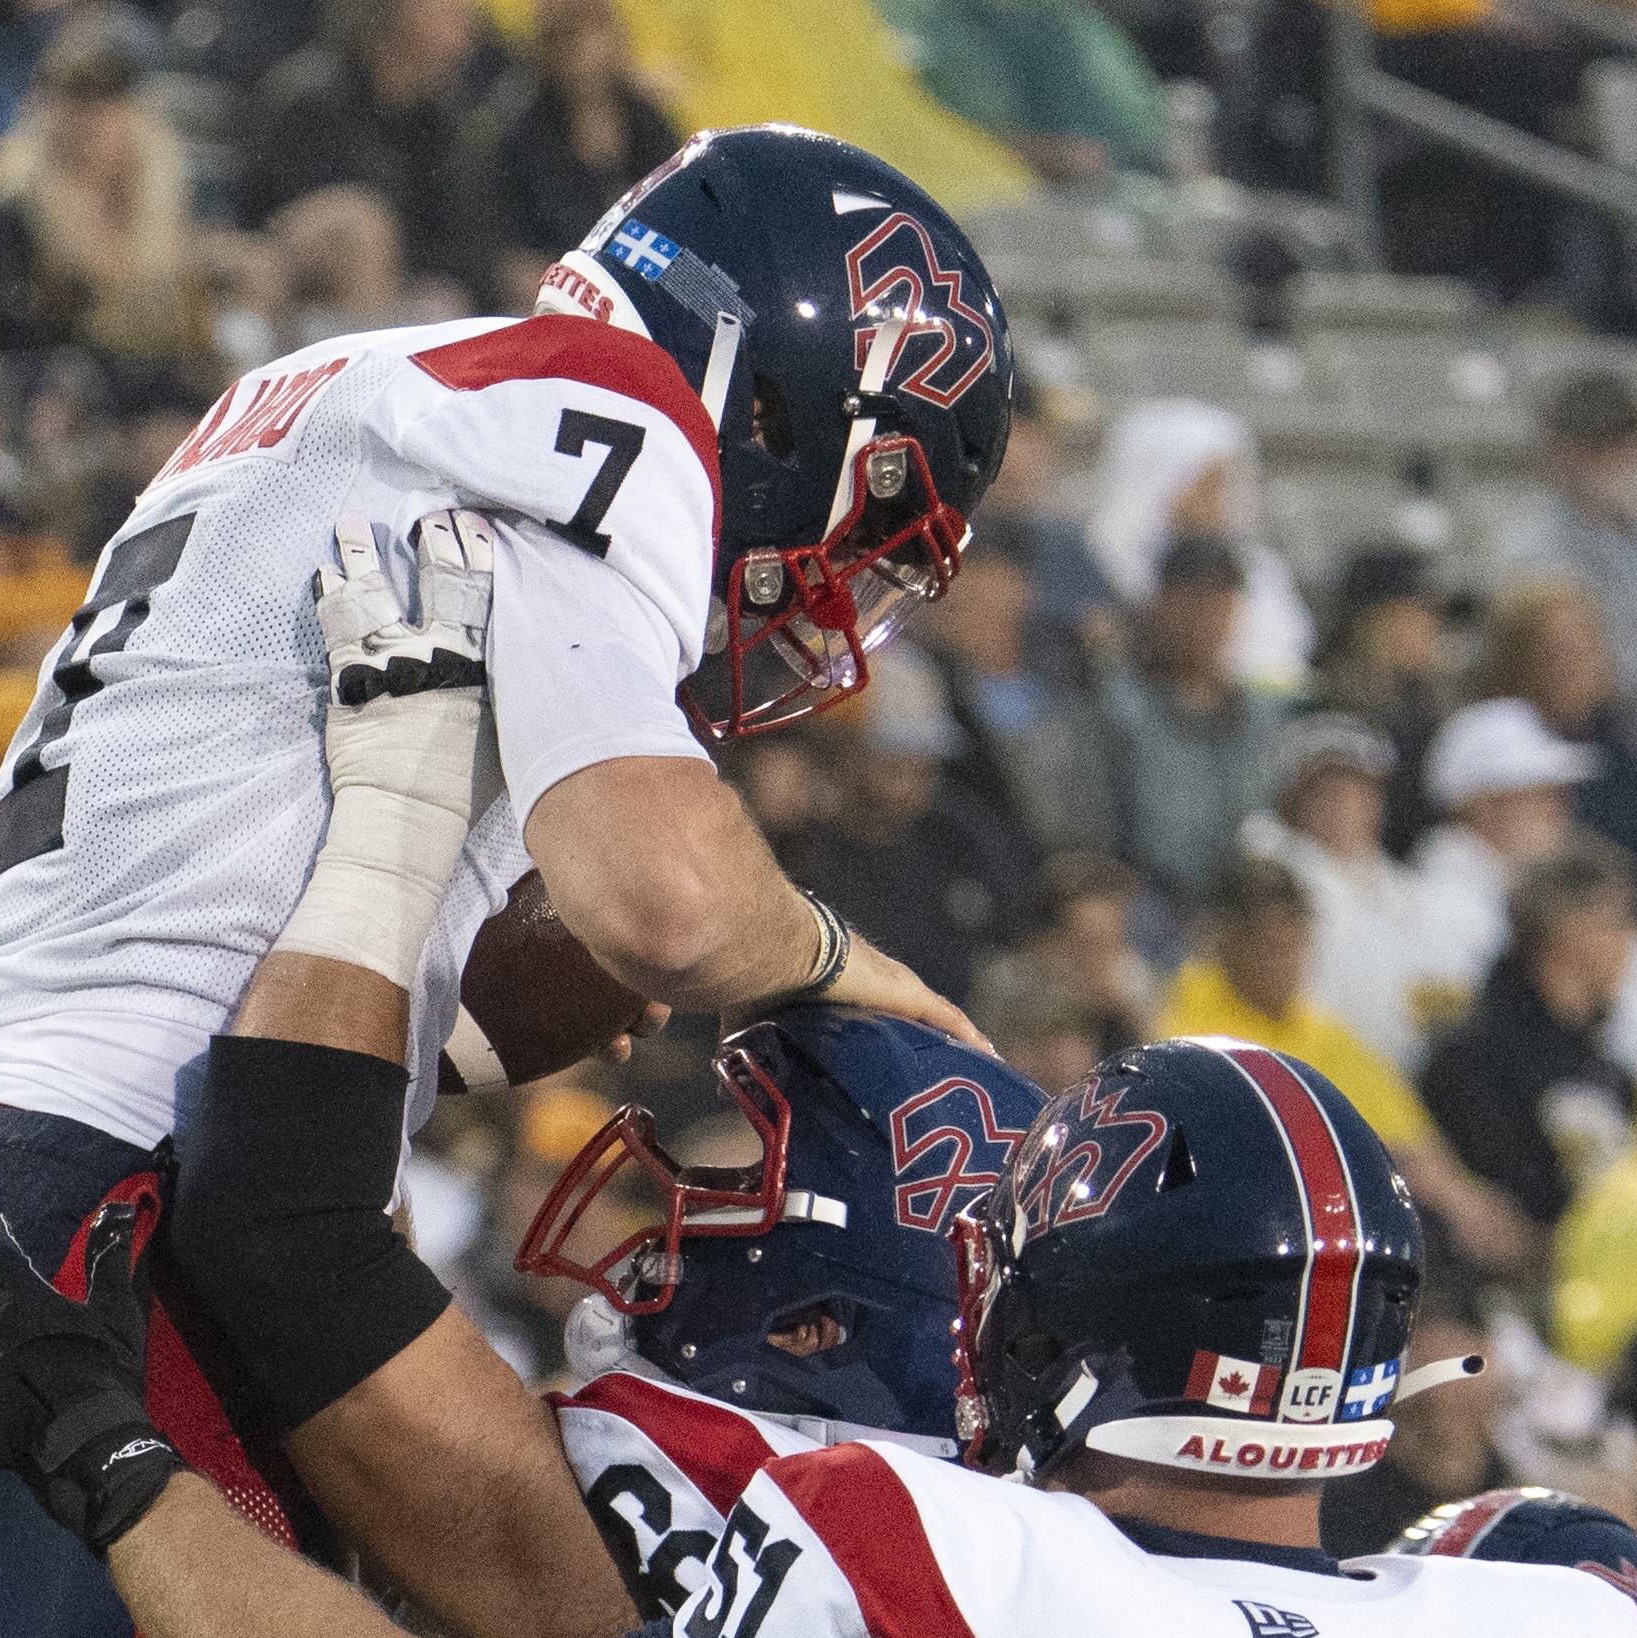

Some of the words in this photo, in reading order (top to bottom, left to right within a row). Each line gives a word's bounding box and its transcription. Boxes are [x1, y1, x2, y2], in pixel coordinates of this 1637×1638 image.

[545, 407, 647, 560] 7
[1290, 1385, 1333, 1406] LCF
[1176, 1434, 1390, 1472] ALOUETTES
